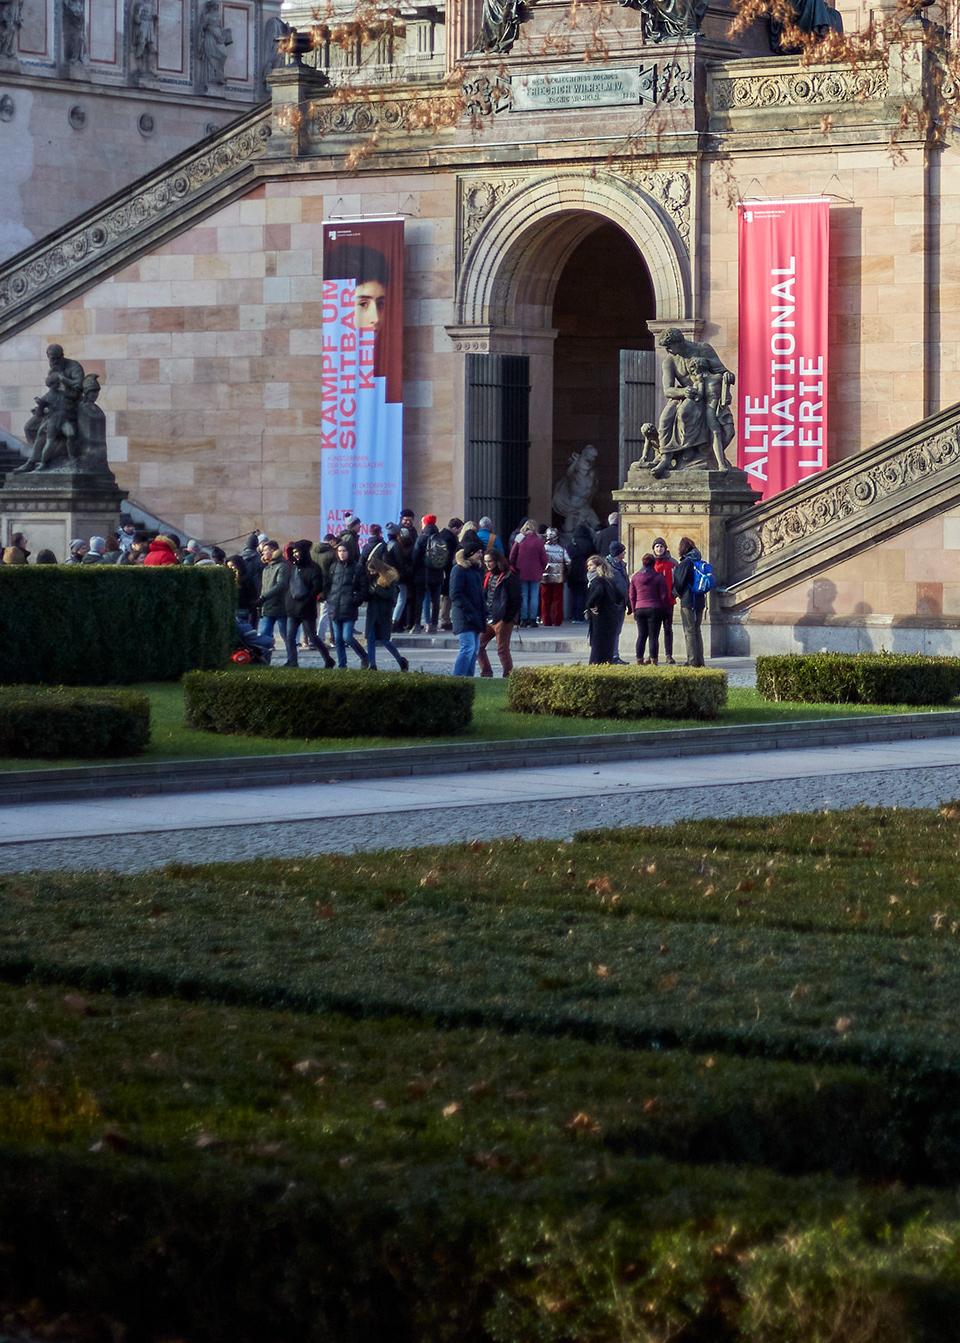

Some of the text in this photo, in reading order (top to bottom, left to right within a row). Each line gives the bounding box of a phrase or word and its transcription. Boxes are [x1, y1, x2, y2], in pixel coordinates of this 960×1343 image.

[526, 86, 571, 96] FRIEDRICH
[574, 83, 613, 93] WILHELM
[321, 335, 338, 449] KAMPF
[339, 279, 356, 449] SICHTBAR-
[359, 327, 375, 389] KEIT
[771, 256, 795, 446] NATIONAL
[743, 395, 769, 481] ALTE
